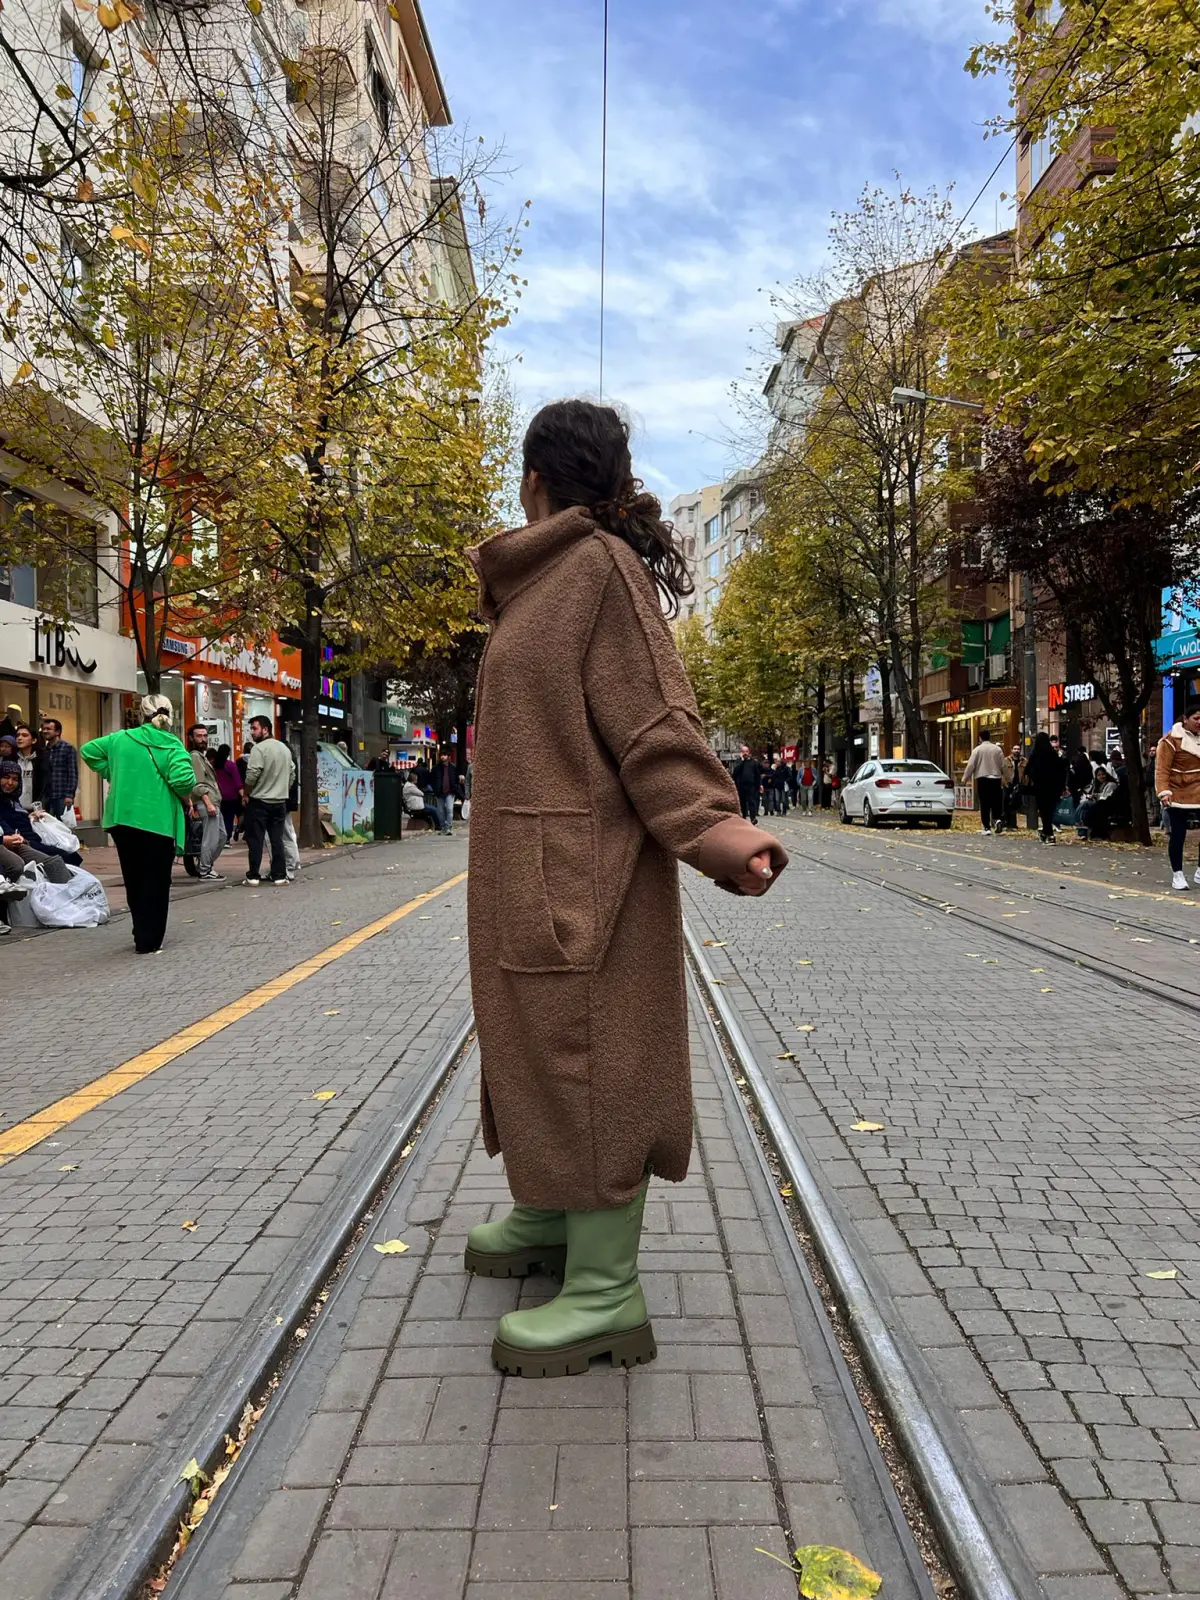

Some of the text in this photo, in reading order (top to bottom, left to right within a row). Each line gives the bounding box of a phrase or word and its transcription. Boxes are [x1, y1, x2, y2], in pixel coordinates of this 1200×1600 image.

[35, 617, 65, 667] LTB
[162, 638, 188, 654] SAMSUNG
[49, 692, 72, 710] LTB
[1049, 683, 1064, 709] IN
